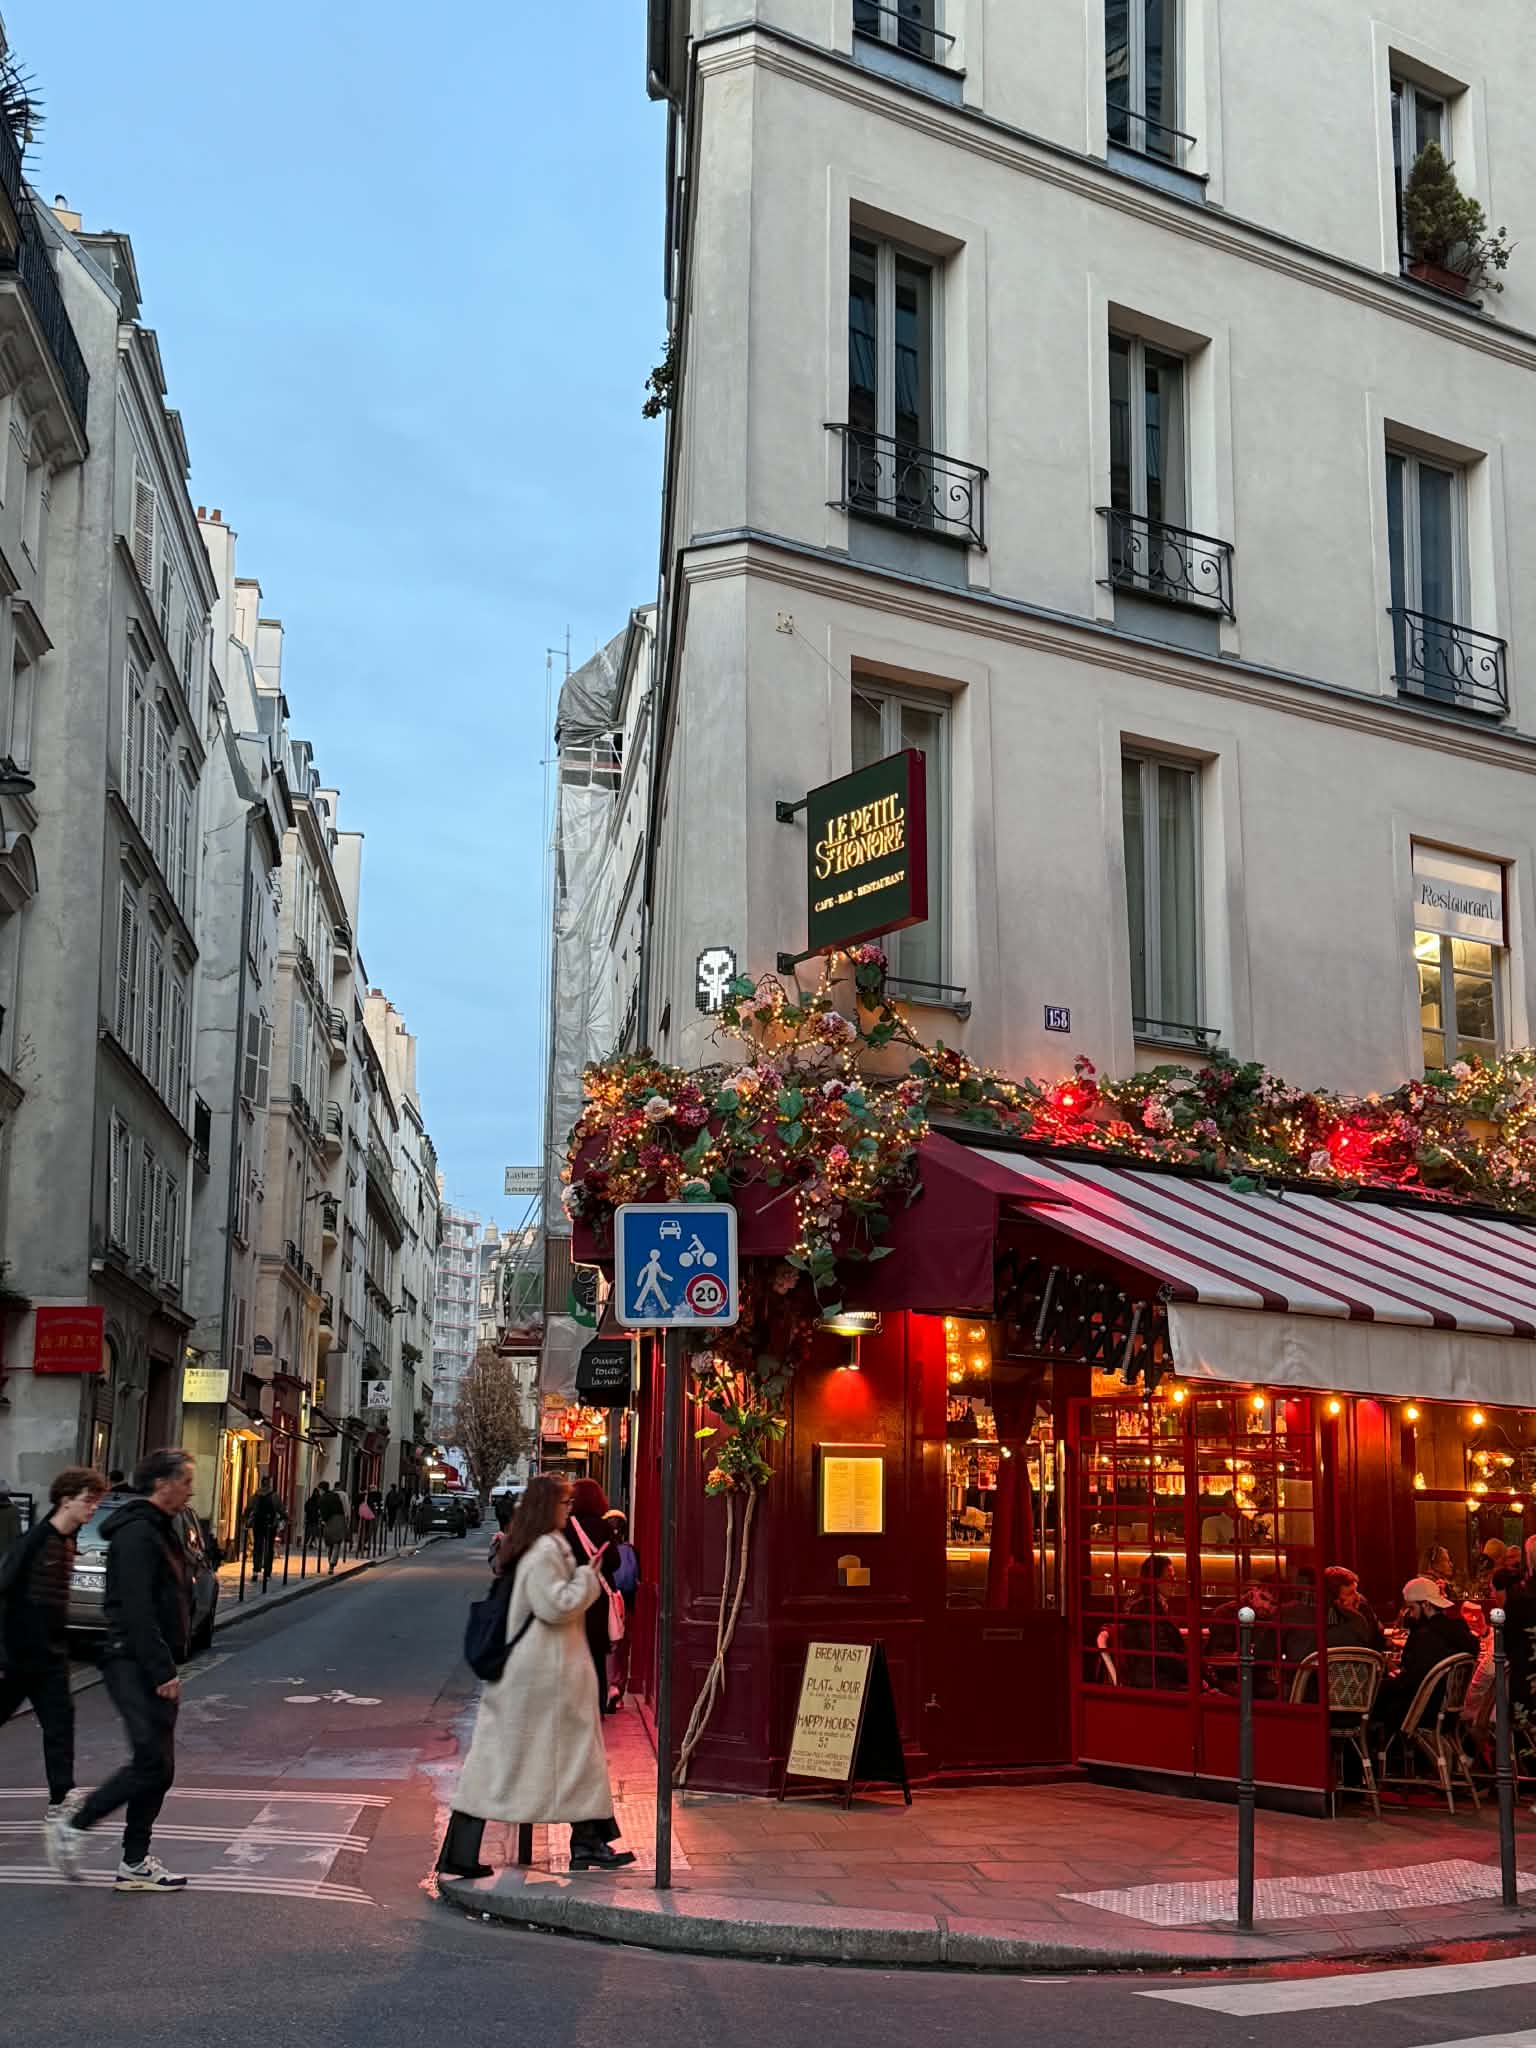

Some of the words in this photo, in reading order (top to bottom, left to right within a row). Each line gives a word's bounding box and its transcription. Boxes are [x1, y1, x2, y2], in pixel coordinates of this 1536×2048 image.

[827, 813, 848, 848] LE
[850, 793, 905, 838] PETIT
[857, 870, 905, 897] RESTAURANT
[1421, 883, 1495, 920] Restaurant
[695, 1287, 718, 1302] 20
[592, 1356, 624, 1365] Ouvert
[595, 1367, 621, 1375] toute
[592, 1377, 602, 1385] la
[807, 1677, 831, 1691] PLAT
[836, 1680, 861, 1694] JOUR
[797, 1714, 824, 1728] HAPPY
[824, 1716, 857, 1732] HOURS
